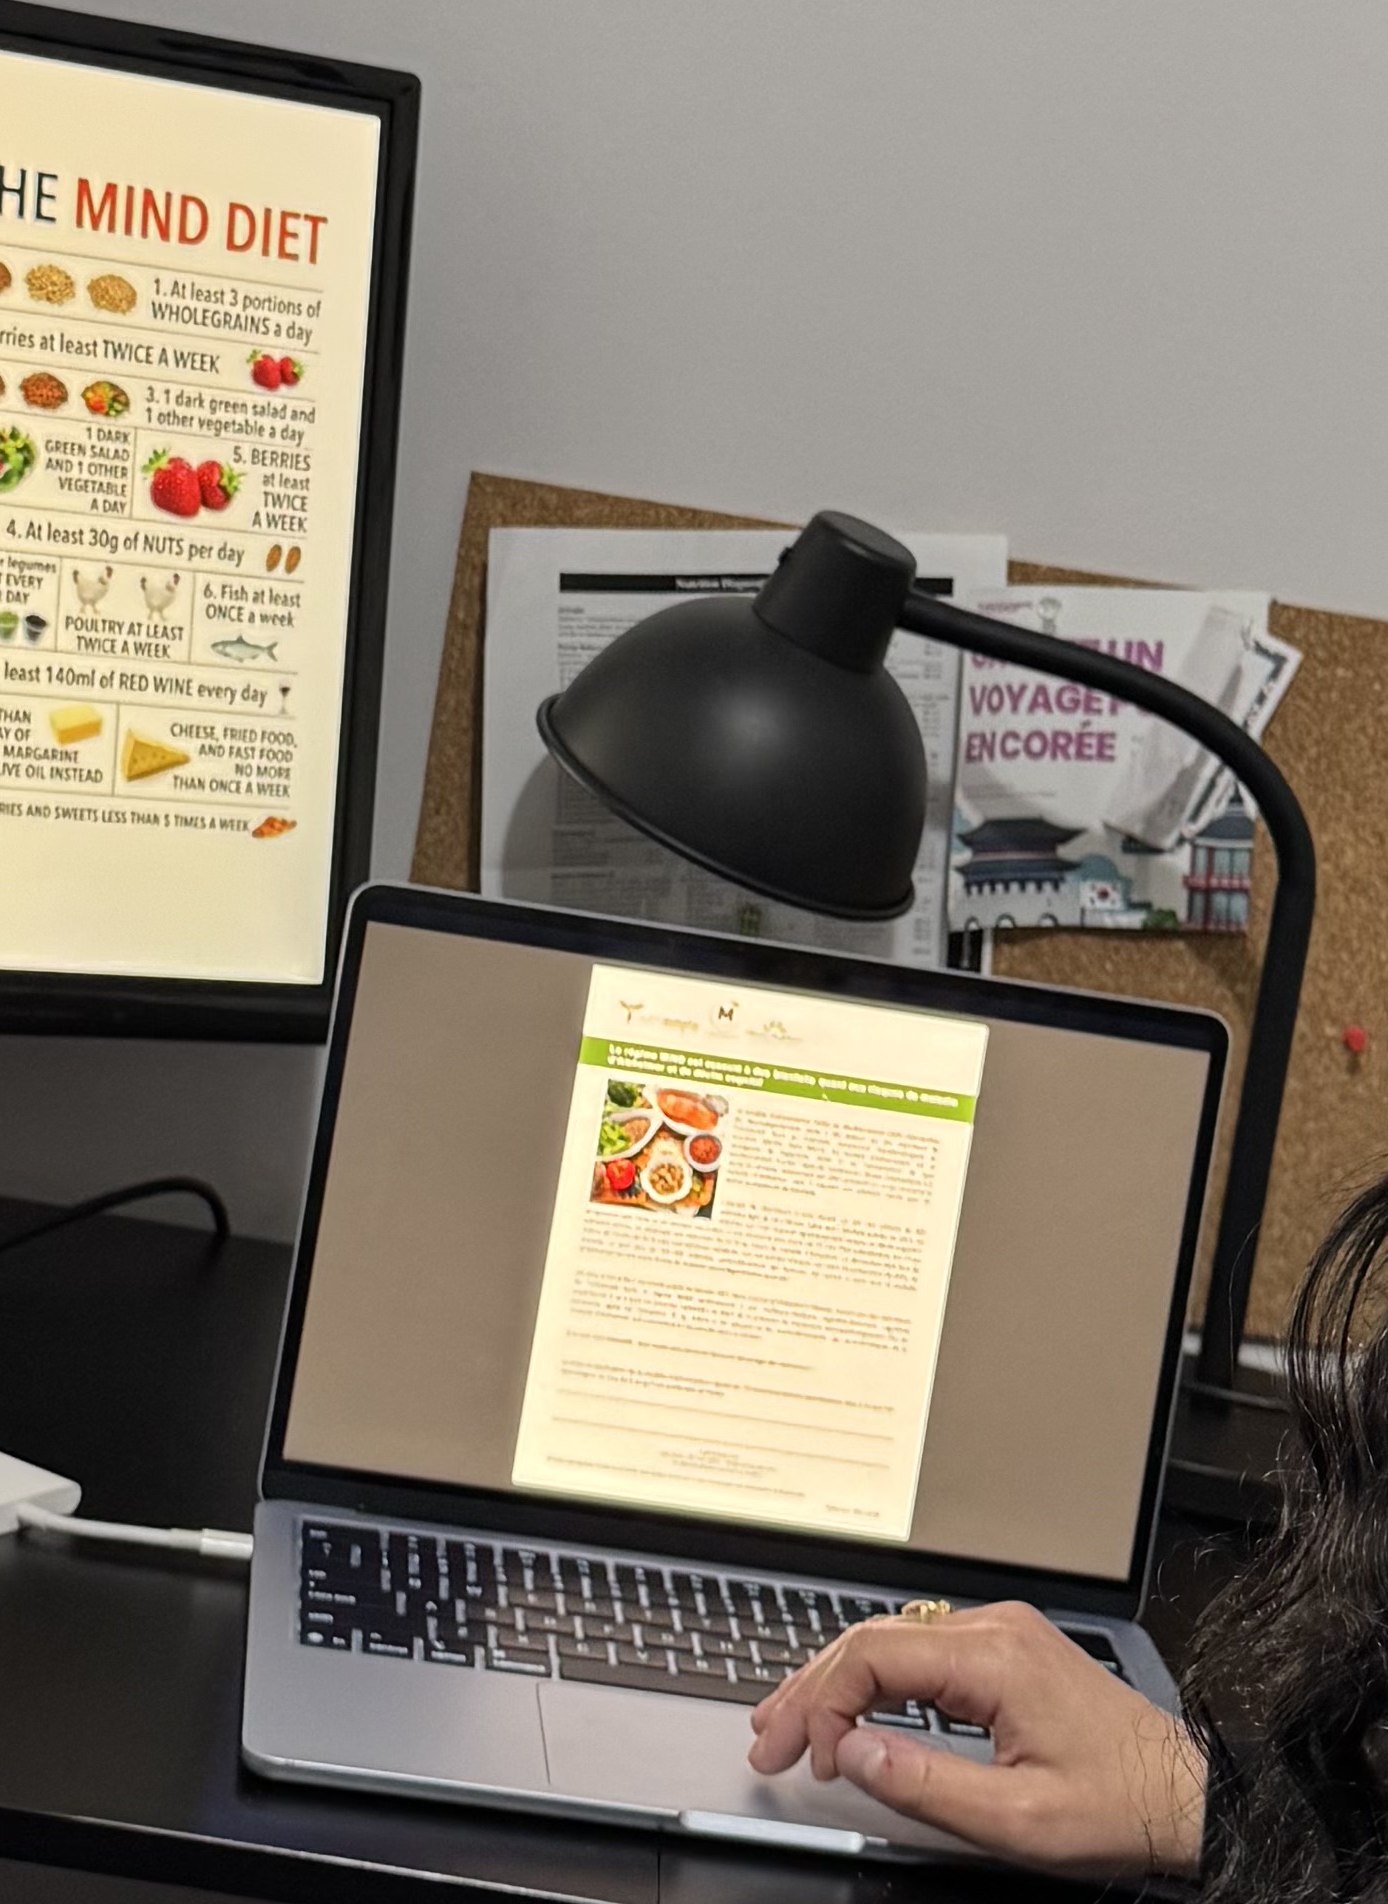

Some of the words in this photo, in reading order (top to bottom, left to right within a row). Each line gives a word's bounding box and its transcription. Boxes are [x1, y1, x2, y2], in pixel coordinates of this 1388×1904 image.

[76, 177, 209, 245] MIND
[226, 202, 328, 265] DIET
[154, 278, 167, 296] 1.
[171, 280, 186, 297] At
[191, 282, 225, 305] least
[229, 289, 238, 307] 3
[242, 295, 302, 316] portions
[307, 301, 321, 318] of
[152, 301, 269, 336] WHOLEGRAINS
[274, 323, 281, 338] a
[286, 322, 312, 346] day
[40, 333, 55, 352] at
[60, 333, 98, 358] least
[103, 340, 154, 365] TWICE
[158, 347, 169, 367] A
[173, 349, 220, 374] WEEK
[164, 389, 170, 404] 1
[175, 390, 205, 408] dark
[209, 398, 248, 414] green
[252, 402, 287, 420] salad
[291, 407, 315, 424] and
[97, 428, 131, 445] DARK
[146, 407, 152, 423] 1
[157, 410, 194, 428] other
[198, 416, 265, 437] vegetable
[269, 426, 276, 439] a
[281, 426, 304, 446] day
[45, 439, 86, 456] GREEN
[90, 445, 129, 462] SALAD
[251, 448, 311, 472] BERRIES
[45, 458, 73, 473] AND
[87, 462, 129, 479] OTHER
[59, 477, 127, 497] VEGETABLE
[263, 473, 275, 487] at
[279, 474, 310, 491] least
[91, 498, 98, 511] A
[103, 499, 127, 514] DAY
[263, 491, 308, 512] TWICE
[252, 511, 261, 528] A
[266, 512, 307, 533] WEEK
[7, 519, 21, 538] 4.
[26, 521, 42, 541] At
[47, 522, 84, 545] least
[89, 528, 119, 554] 30g
[123, 532, 139, 551] of
[143, 534, 184, 555] NUTS
[188, 544, 213, 561] per
[217, 542, 245, 568] day
[221, 584, 248, 602] Fish
[252, 589, 265, 603] at
[269, 588, 301, 608] least
[65, 615, 125, 636] POULTRY
[127, 622, 143, 636] AT
[147, 624, 184, 641] LEAST
[205, 604, 244, 622] ONCE
[260, 611, 294, 628] week
[76, 636, 117, 654] TWICE
[134, 641, 171, 659] WEEK
[4, 660, 40, 682] least
[46, 666, 95, 687] 140ml
[99, 671, 115, 689] of
[119, 672, 149, 692] RED
[153, 676, 193, 696] WINE
[198, 683, 237, 705] every
[241, 684, 267, 708] day
[969, 685, 1102, 716] VOYAGE
[965, 732, 996, 764] EN
[1000, 719, 1117, 762] CORÉE
[25, 764, 46, 780] OIL
[50, 767, 103, 784] INSTEAD
